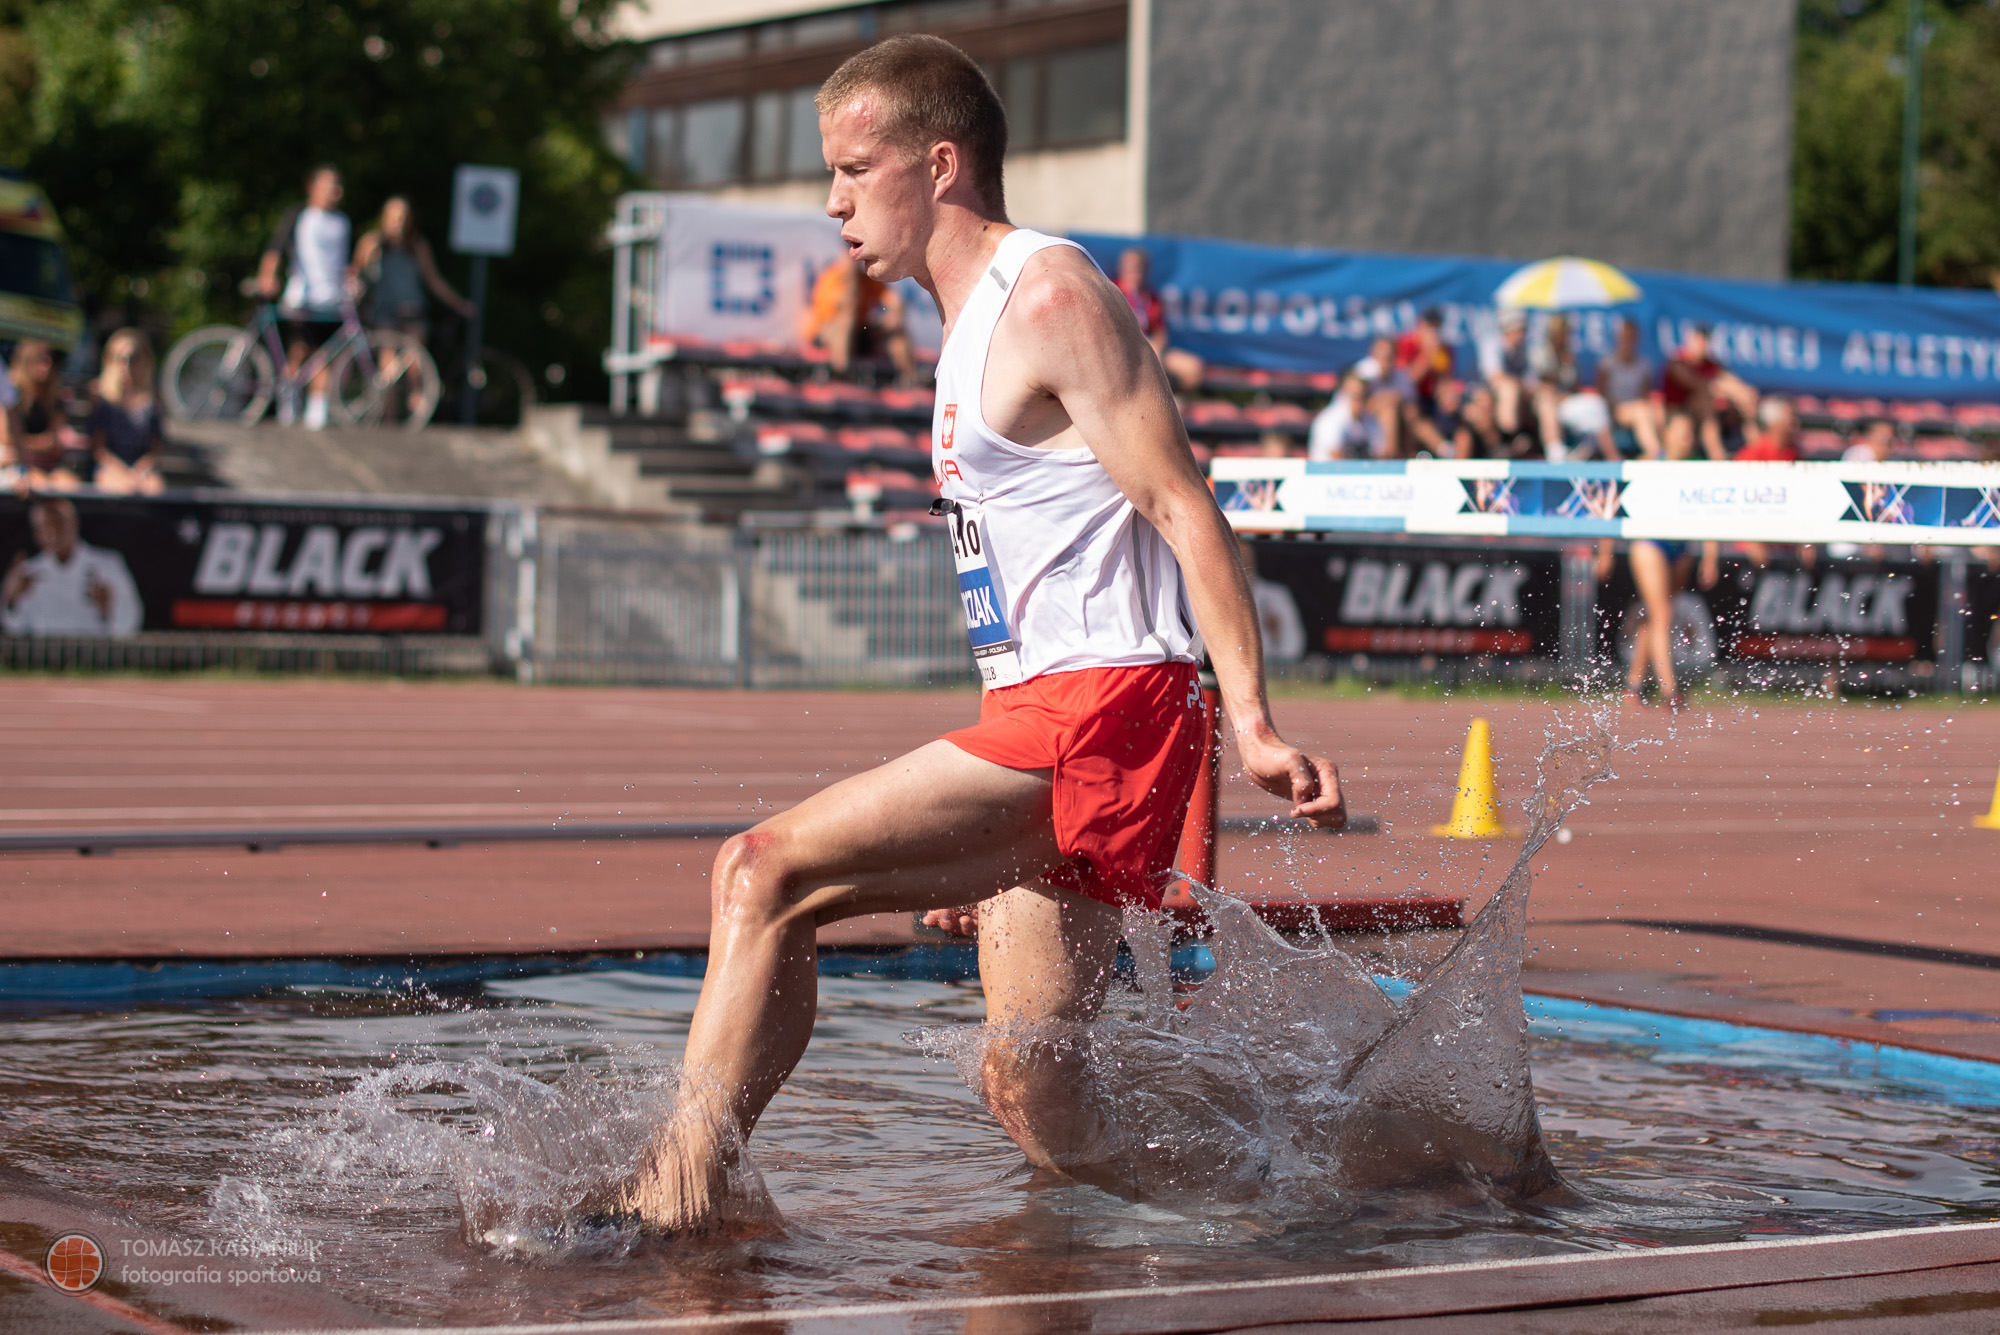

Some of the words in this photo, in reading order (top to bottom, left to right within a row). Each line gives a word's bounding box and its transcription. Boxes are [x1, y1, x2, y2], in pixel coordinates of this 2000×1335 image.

[193, 522, 442, 597] BLACK
[1340, 560, 1528, 625] BLACK
[1752, 572, 1915, 635] BLACK
